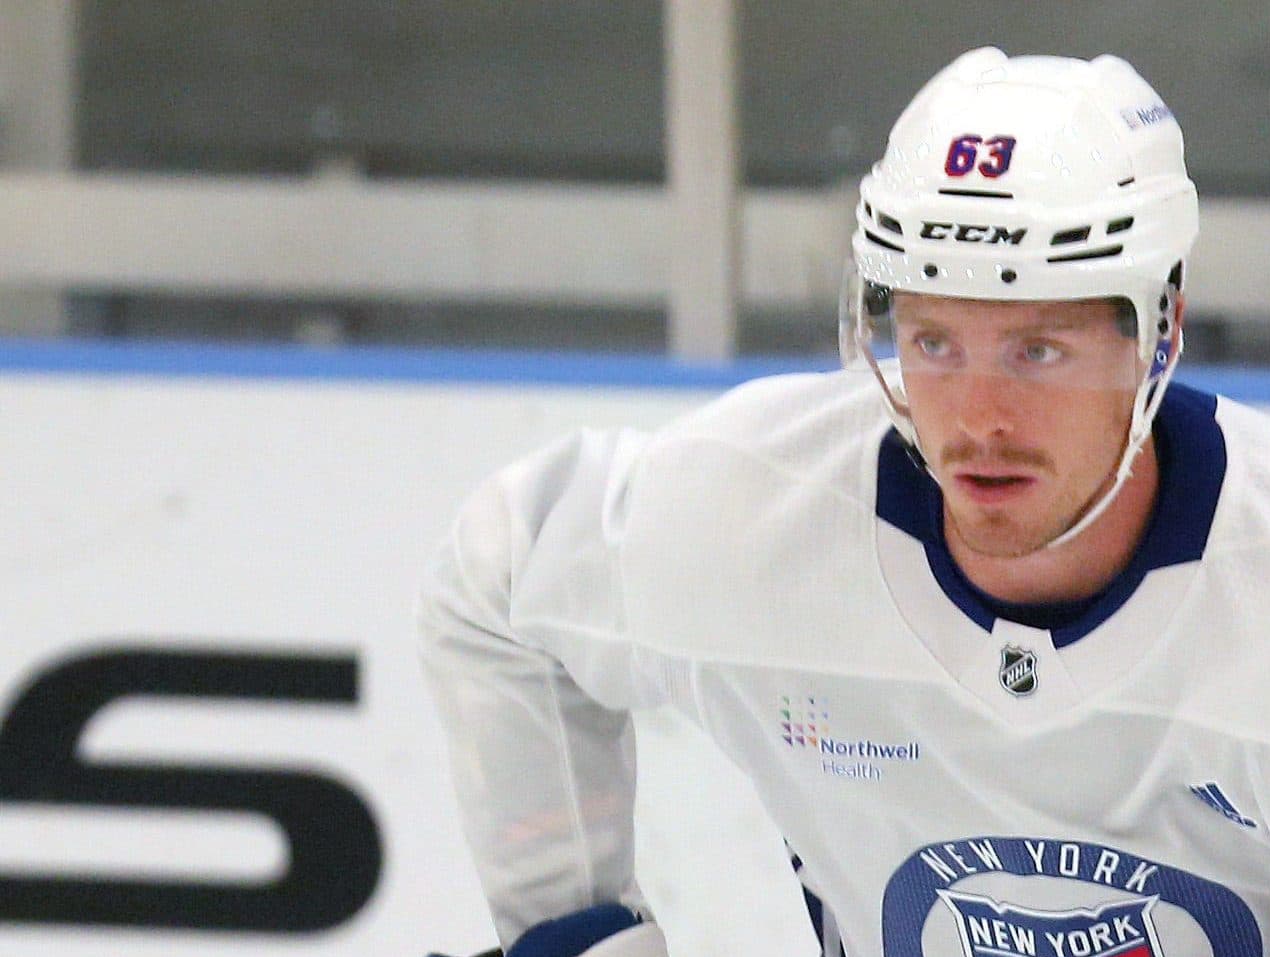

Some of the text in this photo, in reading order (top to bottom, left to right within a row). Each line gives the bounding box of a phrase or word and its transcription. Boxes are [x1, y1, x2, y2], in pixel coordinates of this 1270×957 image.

[944, 134, 1017, 178] 63
[920, 220, 1028, 246] CCM
[1005, 660, 1031, 686] NHL
[820, 737, 919, 760] Northwell
[822, 760, 882, 782] Health
[919, 838, 1159, 893] NEW YORK
[968, 914, 1036, 957] NEW
